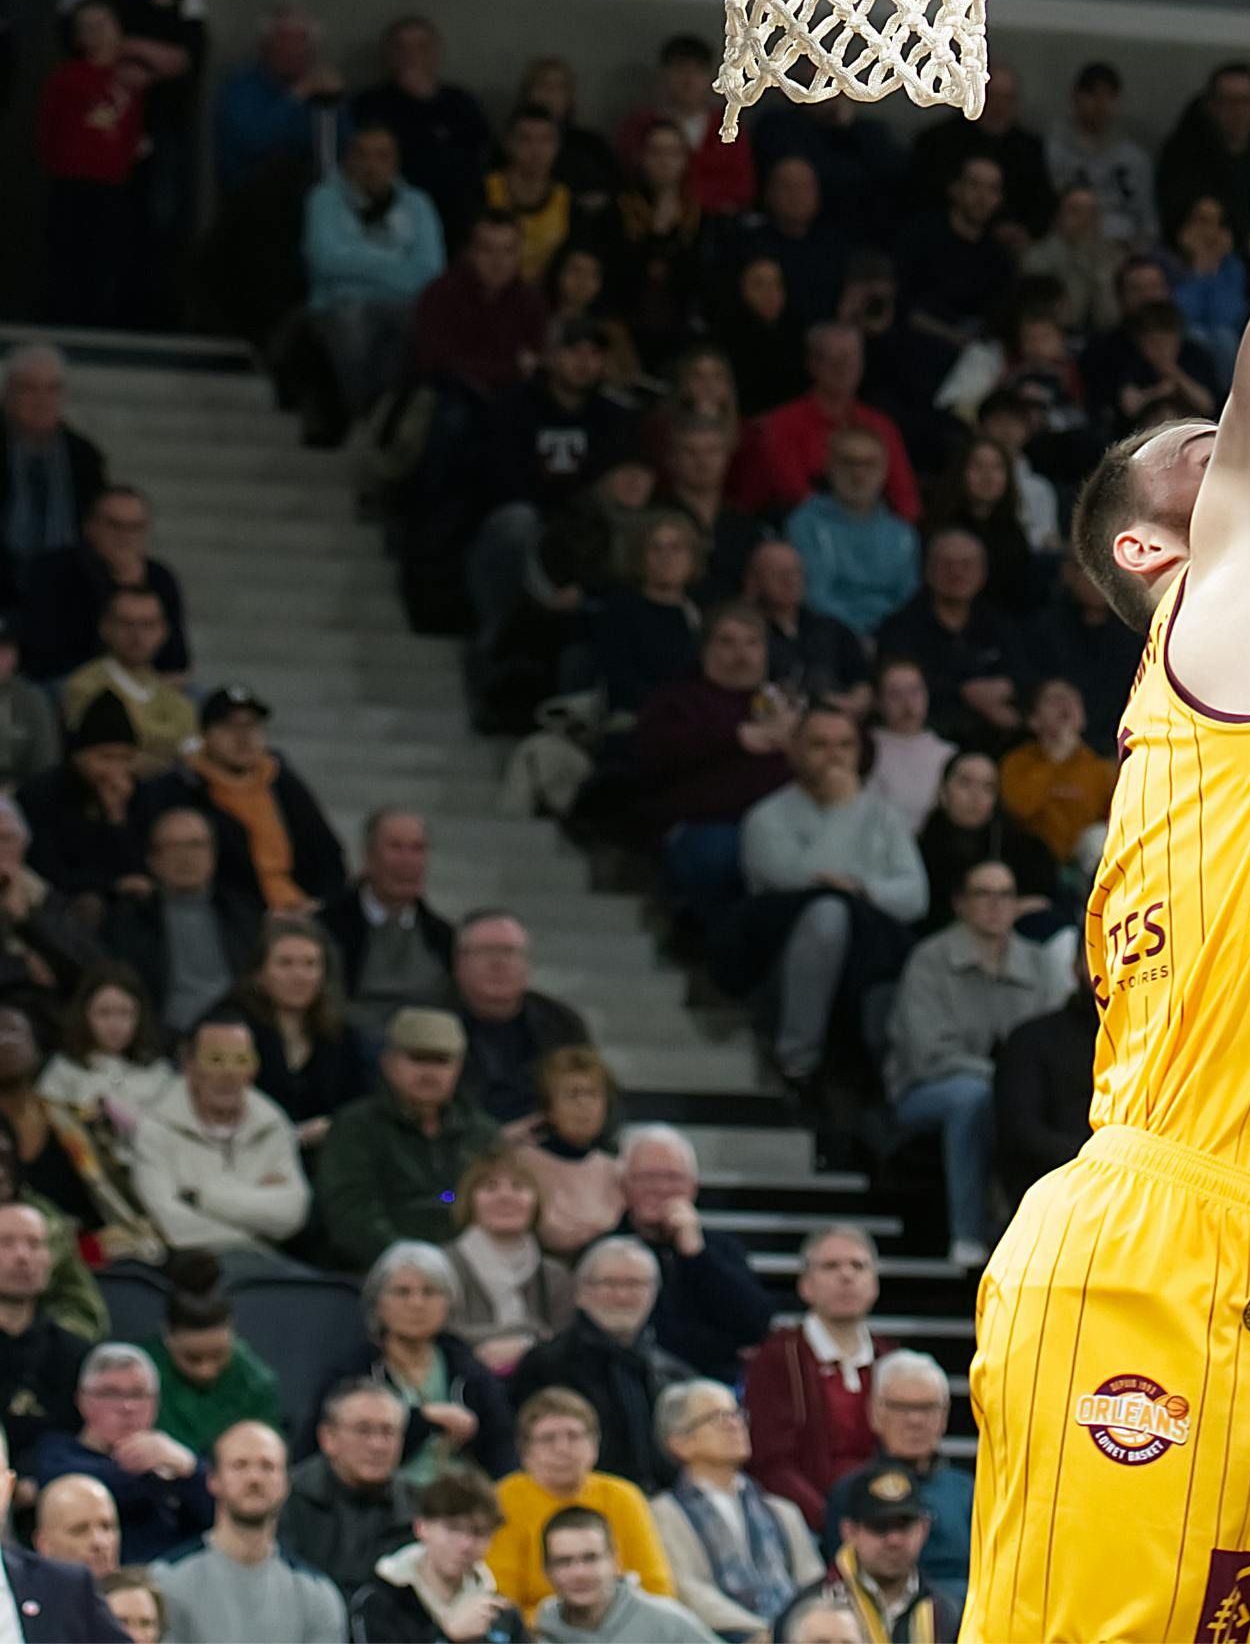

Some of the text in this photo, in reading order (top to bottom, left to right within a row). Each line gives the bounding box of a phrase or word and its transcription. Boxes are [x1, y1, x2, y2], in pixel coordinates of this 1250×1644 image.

[1112, 965, 1169, 996] TOIRES
[1095, 1430, 1164, 1462] LOIRET BASKET
